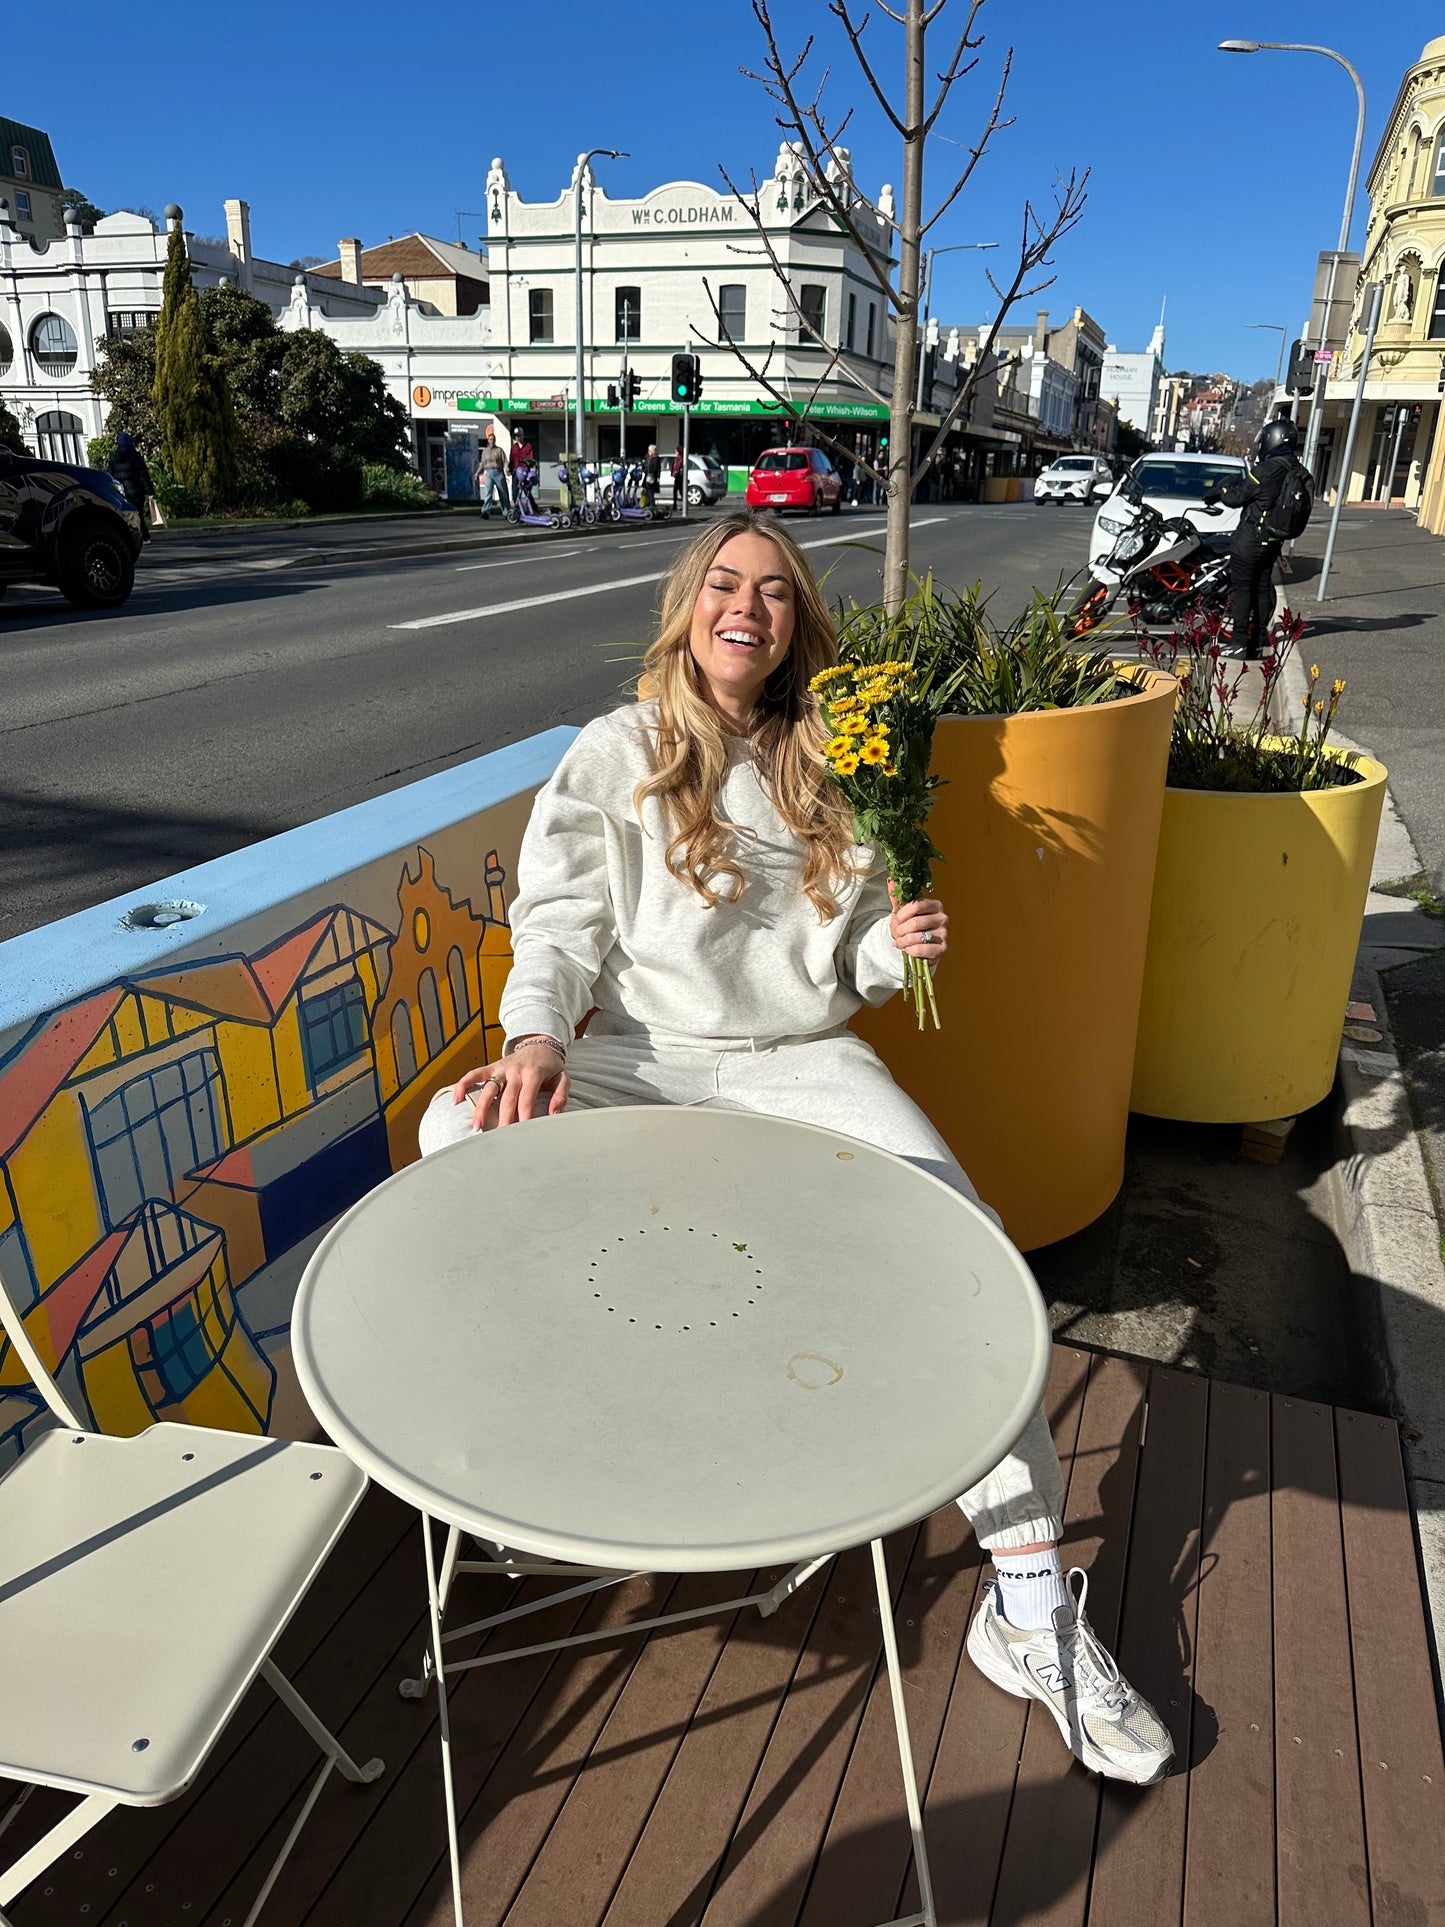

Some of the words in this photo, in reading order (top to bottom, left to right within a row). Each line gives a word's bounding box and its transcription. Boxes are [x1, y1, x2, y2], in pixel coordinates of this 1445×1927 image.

[508, 401, 528, 410] Peter
[638, 402, 666, 411] Greens
[701, 402, 711, 411] for
[714, 402, 751, 412] Tasmania
[826, 405, 878, 416] Whish-Wilson
